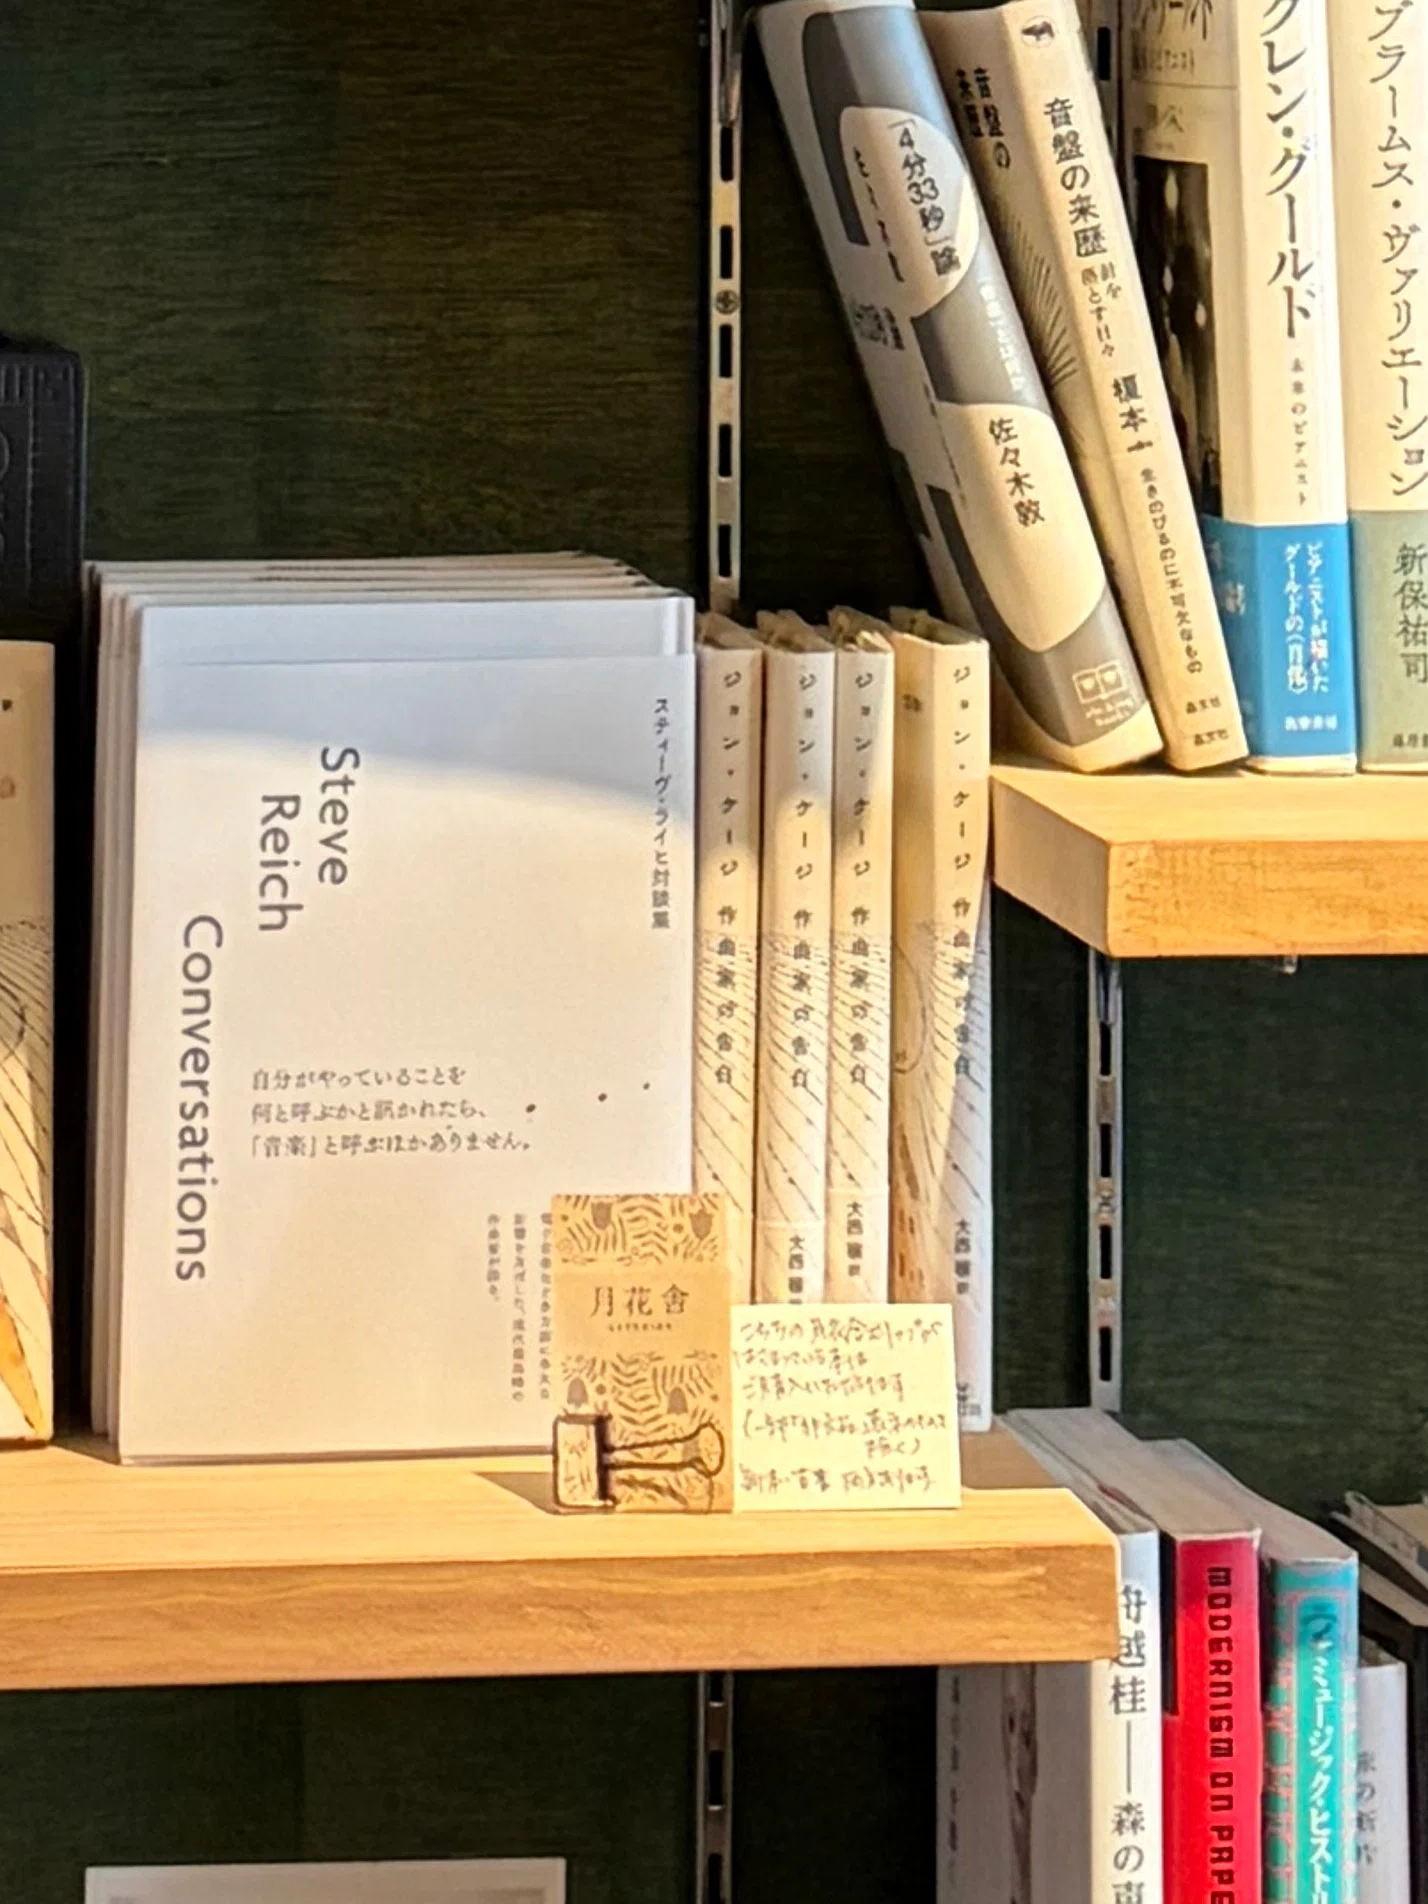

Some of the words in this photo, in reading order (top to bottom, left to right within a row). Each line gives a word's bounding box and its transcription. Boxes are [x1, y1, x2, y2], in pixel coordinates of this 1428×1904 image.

[1043, 96, 1109, 259] 音盤の来歴
[988, 416, 1047, 527] 佐々木敦
[316, 746, 361, 888] Steve
[650, 695, 671, 932] スティーヴ・ライヒ対談集
[718, 669, 742, 879] ジョン・ケージ
[795, 671, 818, 880] ジョン・ケージ
[852, 670, 875, 880] ジョン・ケージ
[952, 663, 972, 873] ジョン・ケージ
[257, 794, 305, 934] Reich
[251, 1065, 468, 1091] 自分がやっていることを
[714, 903, 740, 1086] 作曲家の告白
[791, 906, 814, 1090] 作曲家の告白
[848, 904, 872, 1088] 作曲家の告白
[175, 914, 224, 1283] Conversations
[250, 1099, 488, 1125] 何と呼ぶかと訊かれたら、
[590, 1283, 690, 1318] 月花舎
[1206, 1565, 1234, 1759] MODERNISM
[1209, 1771, 1234, 1813] ON
